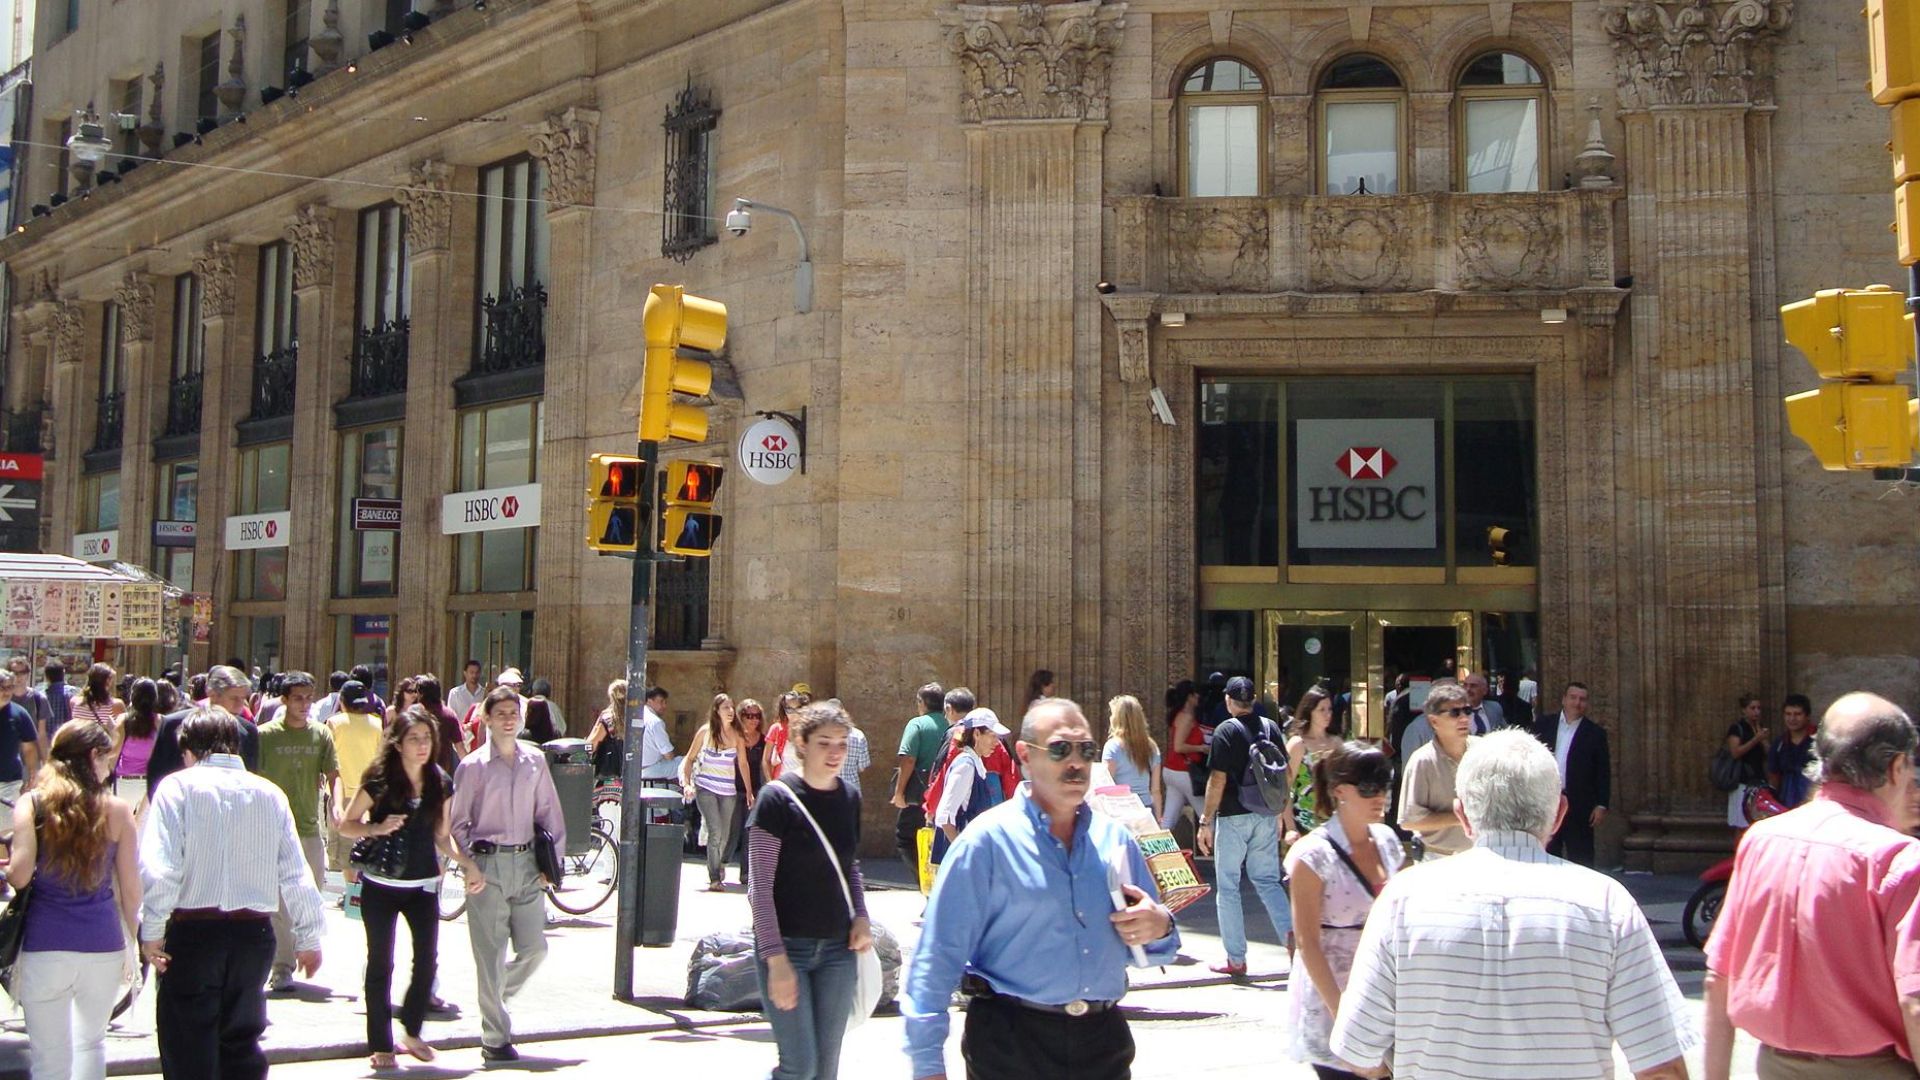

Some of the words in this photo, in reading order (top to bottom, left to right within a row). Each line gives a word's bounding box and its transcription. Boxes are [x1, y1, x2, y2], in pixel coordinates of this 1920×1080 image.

[749, 451, 798, 470] HSBC
[464, 497, 499, 523] HSBC
[1308, 485, 1426, 522] HSBC
[361, 509, 398, 520] BANELCO
[240, 520, 264, 541] HSBC
